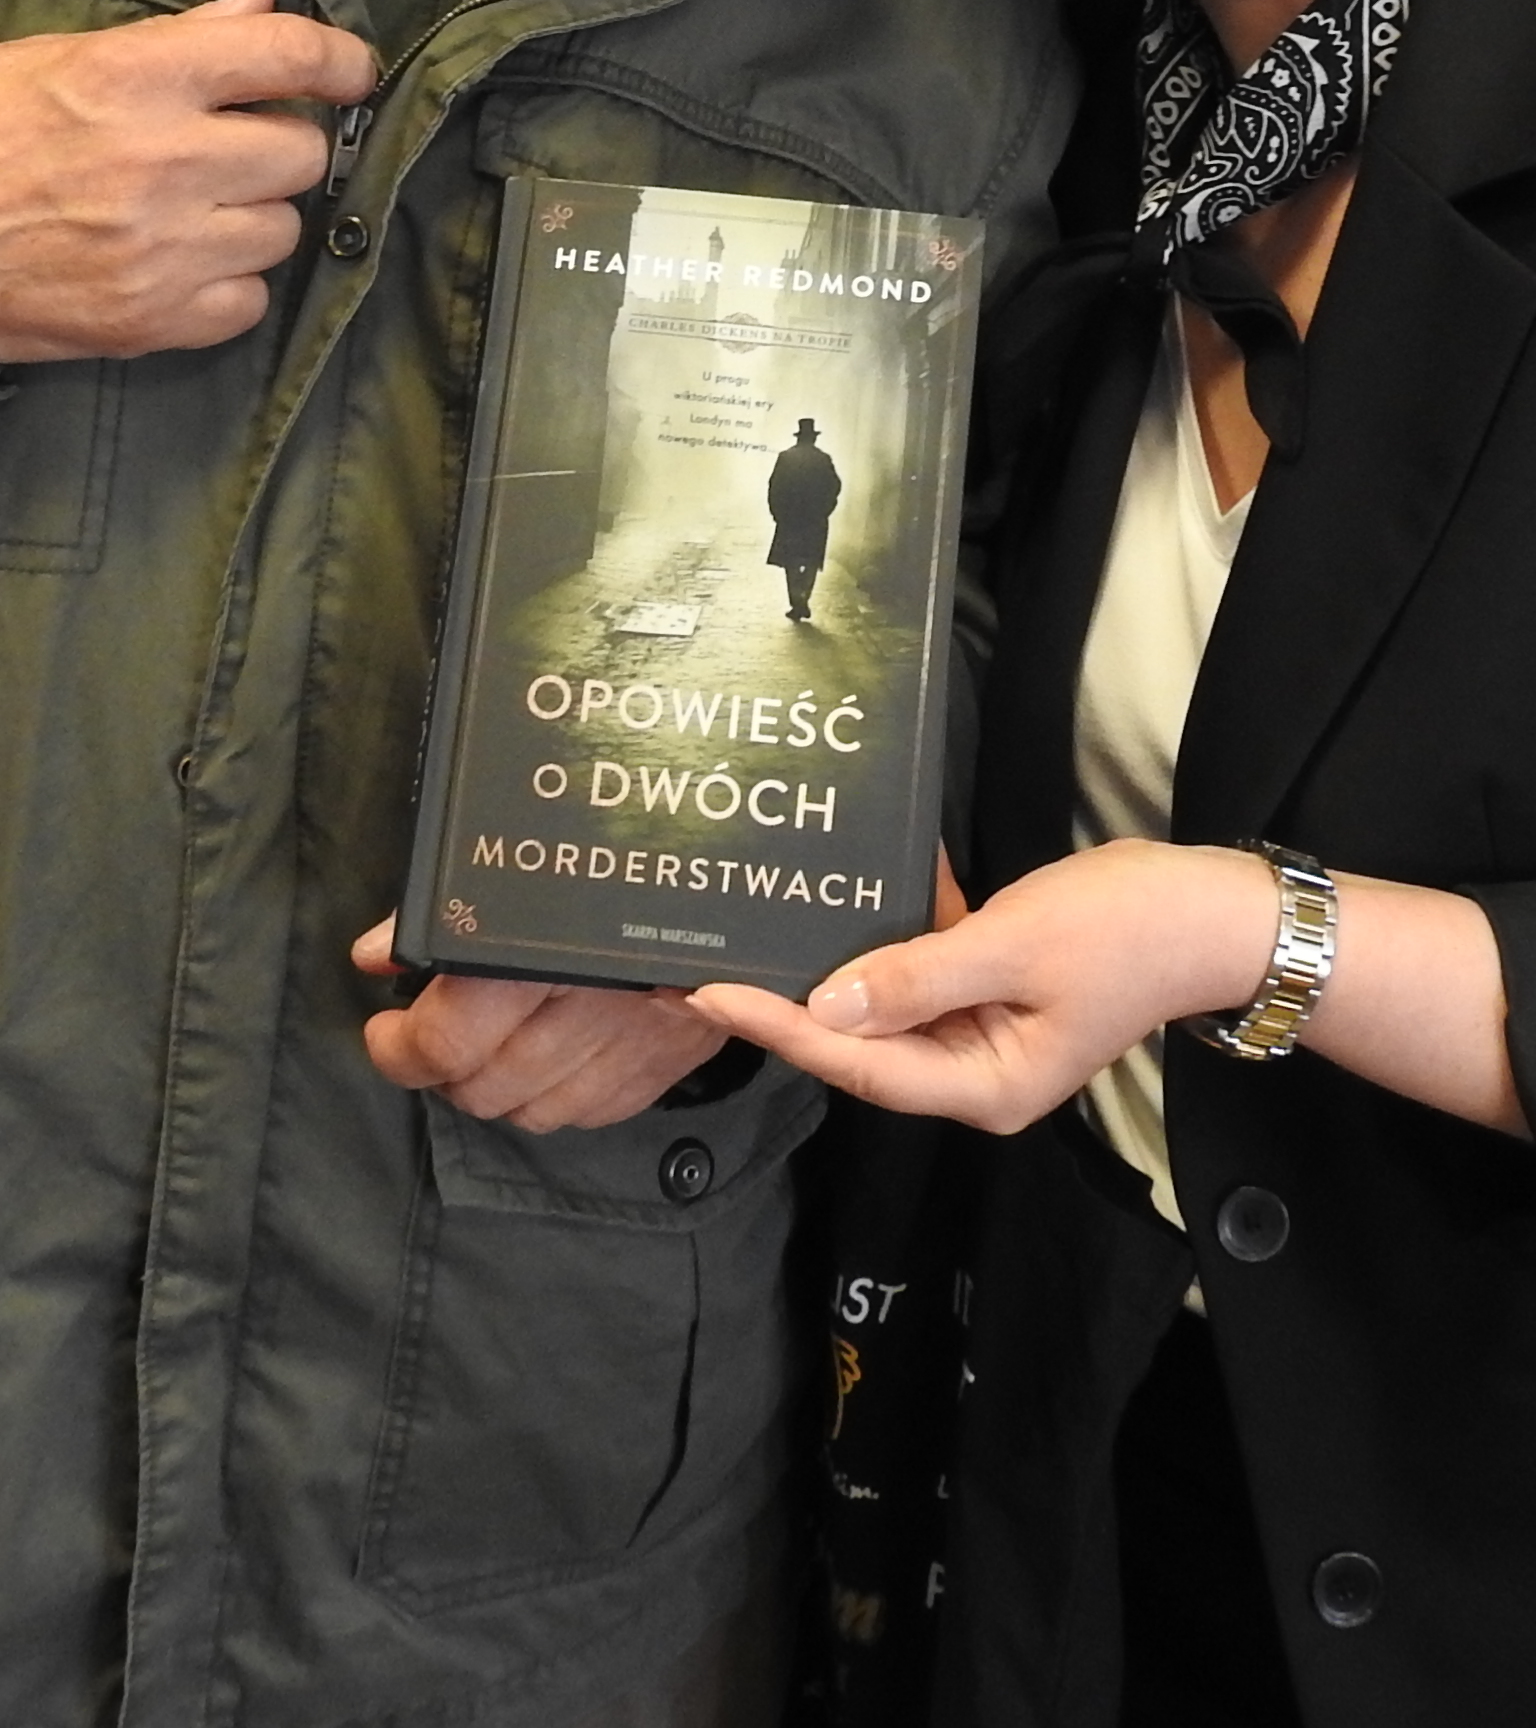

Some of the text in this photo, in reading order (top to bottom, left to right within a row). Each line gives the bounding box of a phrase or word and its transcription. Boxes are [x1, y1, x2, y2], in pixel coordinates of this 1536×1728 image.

[553, 246, 933, 304] HEATHER REDMOND
[628, 318, 853, 349] CHARLES DICKENS NA TROPIE
[702, 371, 750, 388] U progu
[673, 390, 775, 412] wiktoriańskiej ery
[689, 413, 753, 429] Londyn ma
[657, 432, 704, 448] nowego
[526, 674, 865, 753] OPOWIEŚĆ
[590, 760, 837, 833] DWÓCH
[471, 834, 885, 911] MORDERSTWACH
[622, 922, 727, 949] SKARPA WARSZAWSKA
